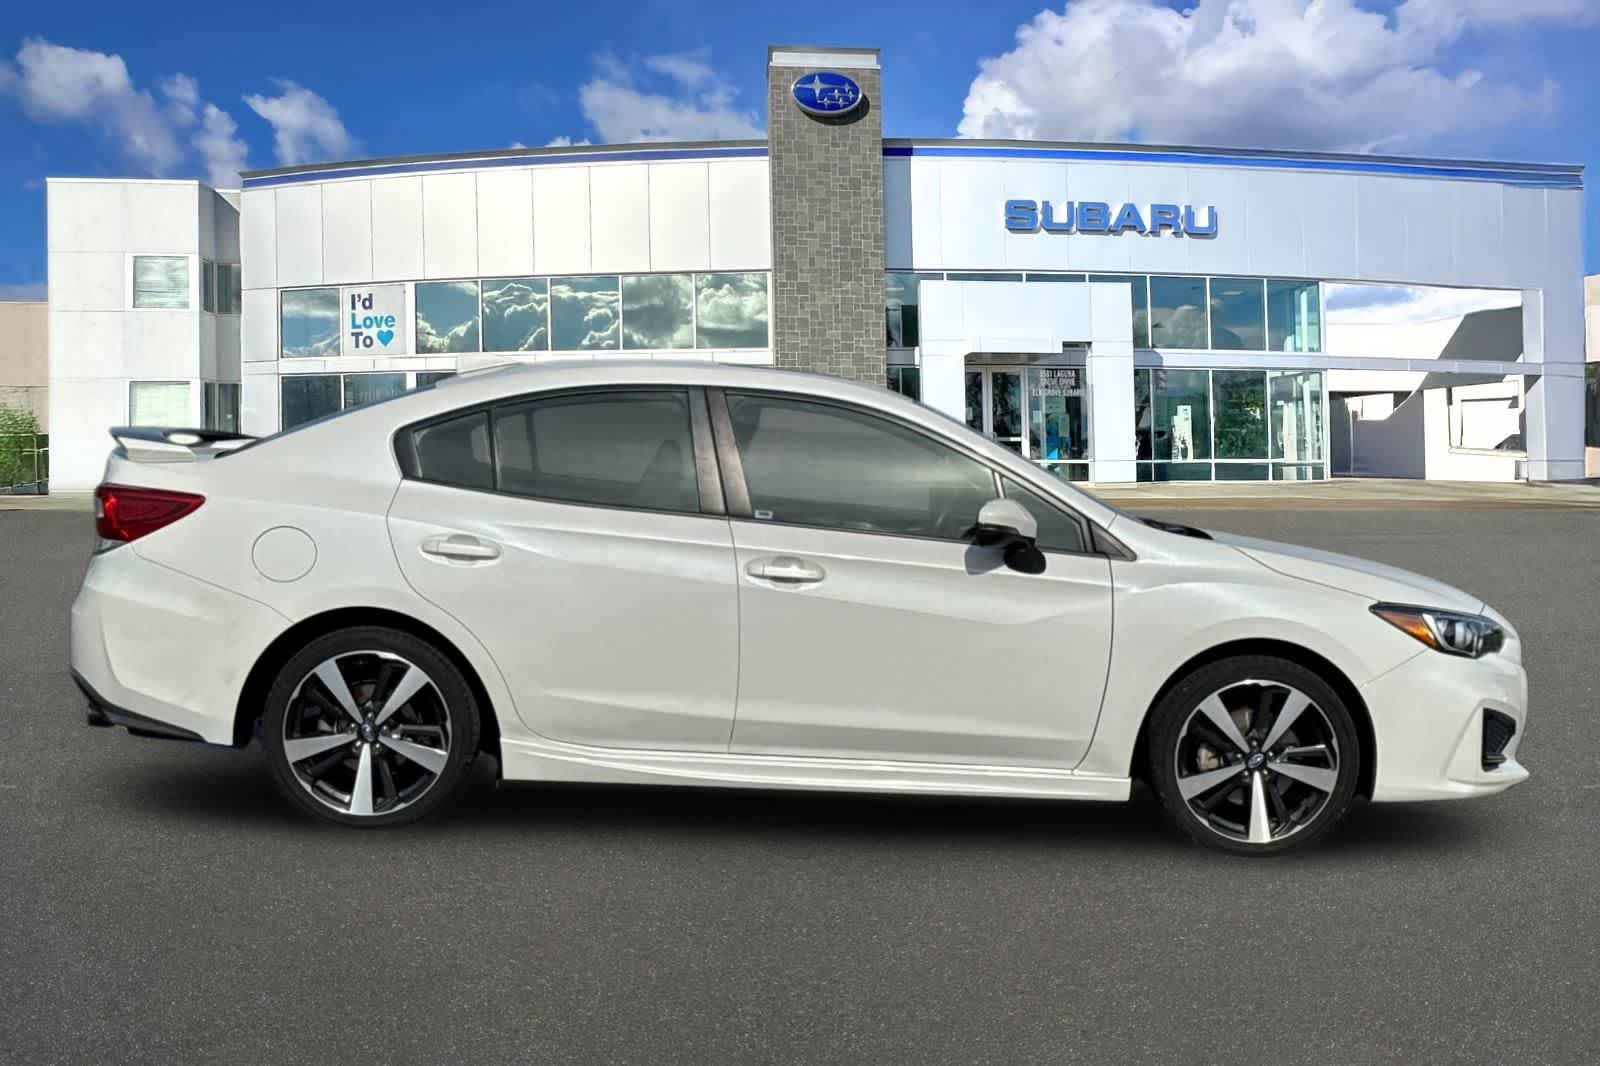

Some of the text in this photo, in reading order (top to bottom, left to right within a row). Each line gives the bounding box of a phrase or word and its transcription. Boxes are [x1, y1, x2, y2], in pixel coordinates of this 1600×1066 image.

[1004, 199, 1217, 239] SUBARU
[351, 293, 373, 310] I’d
[351, 312, 396, 329] Love
[351, 331, 374, 348] To
